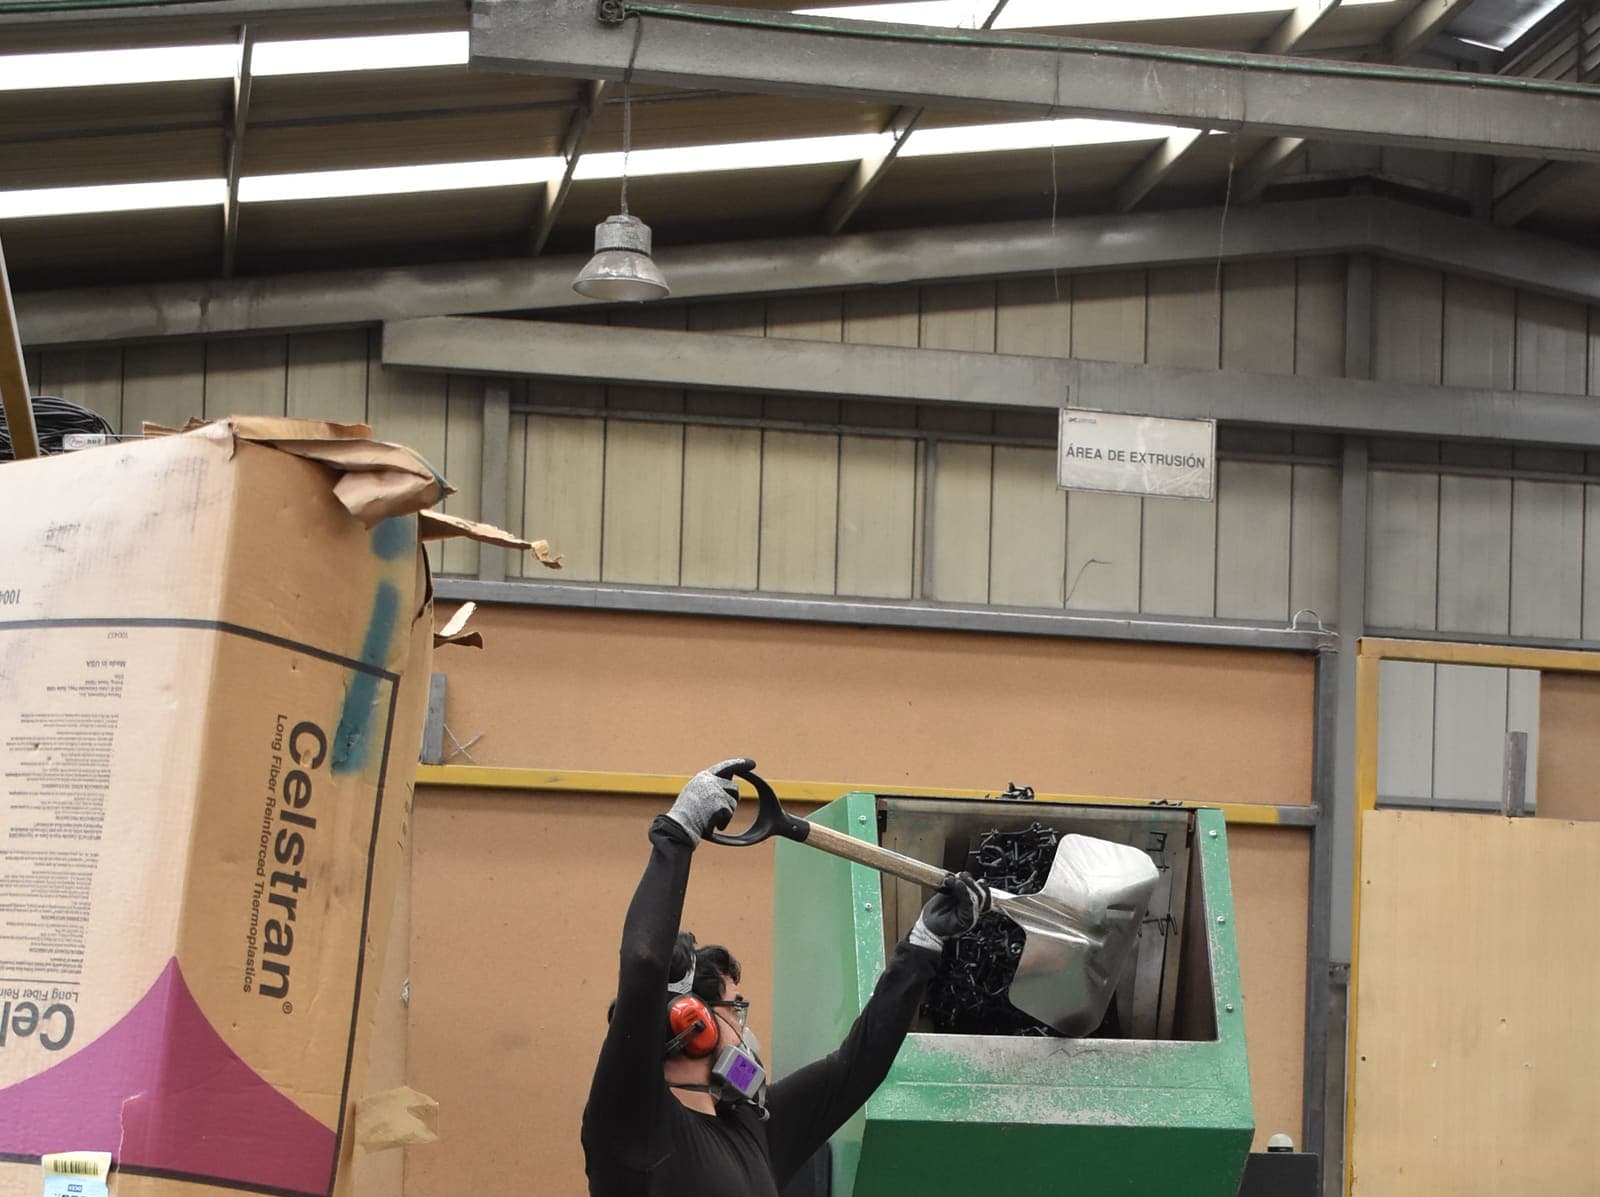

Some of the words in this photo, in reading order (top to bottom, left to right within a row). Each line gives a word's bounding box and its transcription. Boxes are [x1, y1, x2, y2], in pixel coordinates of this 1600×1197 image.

[1066, 443, 1103, 459] ÁREA
[1107, 449, 1125, 462] DE
[1130, 450, 1206, 469] EXTRUSIÓN
[86, 660, 100, 668] USA
[108, 660, 126, 668] Made
[271, 713, 288, 752] Long
[267, 755, 282, 795] Fiber
[255, 796, 277, 878] Reinforced
[243, 881, 265, 993] Thermoplastics
[22, 989, 48, 1001] Fiber
[51, 988, 79, 1003] Long
